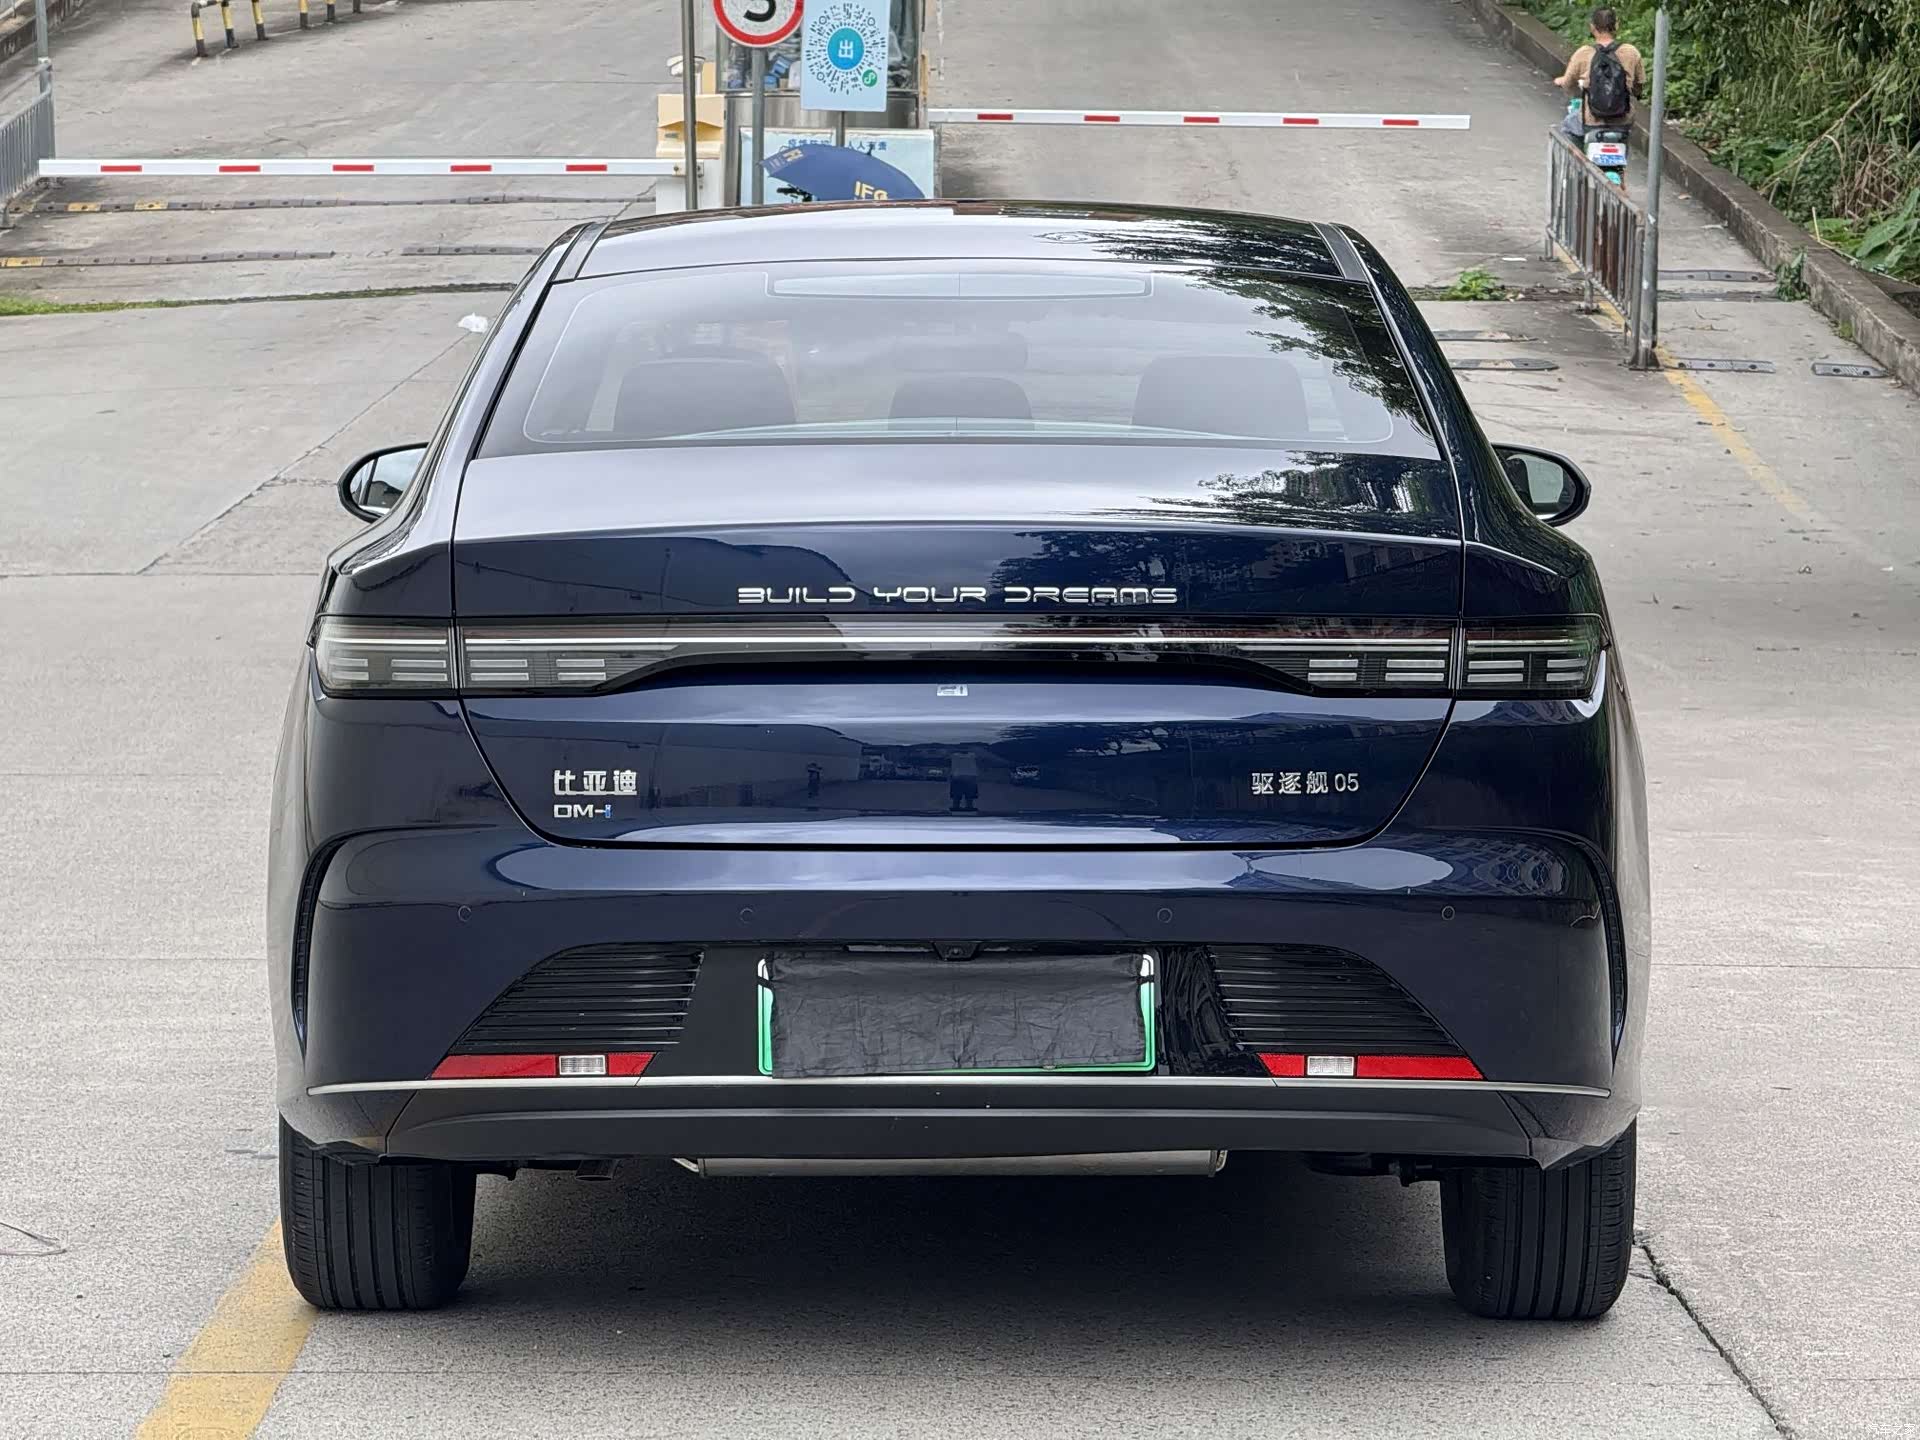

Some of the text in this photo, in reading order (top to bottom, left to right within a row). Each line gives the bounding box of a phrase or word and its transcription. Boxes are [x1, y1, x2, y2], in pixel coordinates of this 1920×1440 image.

[838, 40, 854, 59] 出
[737, 586, 1178, 604] BUILD YOUR DREAMS
[553, 769, 638, 796] 比亚迪
[553, 804, 612, 819] DM-i
